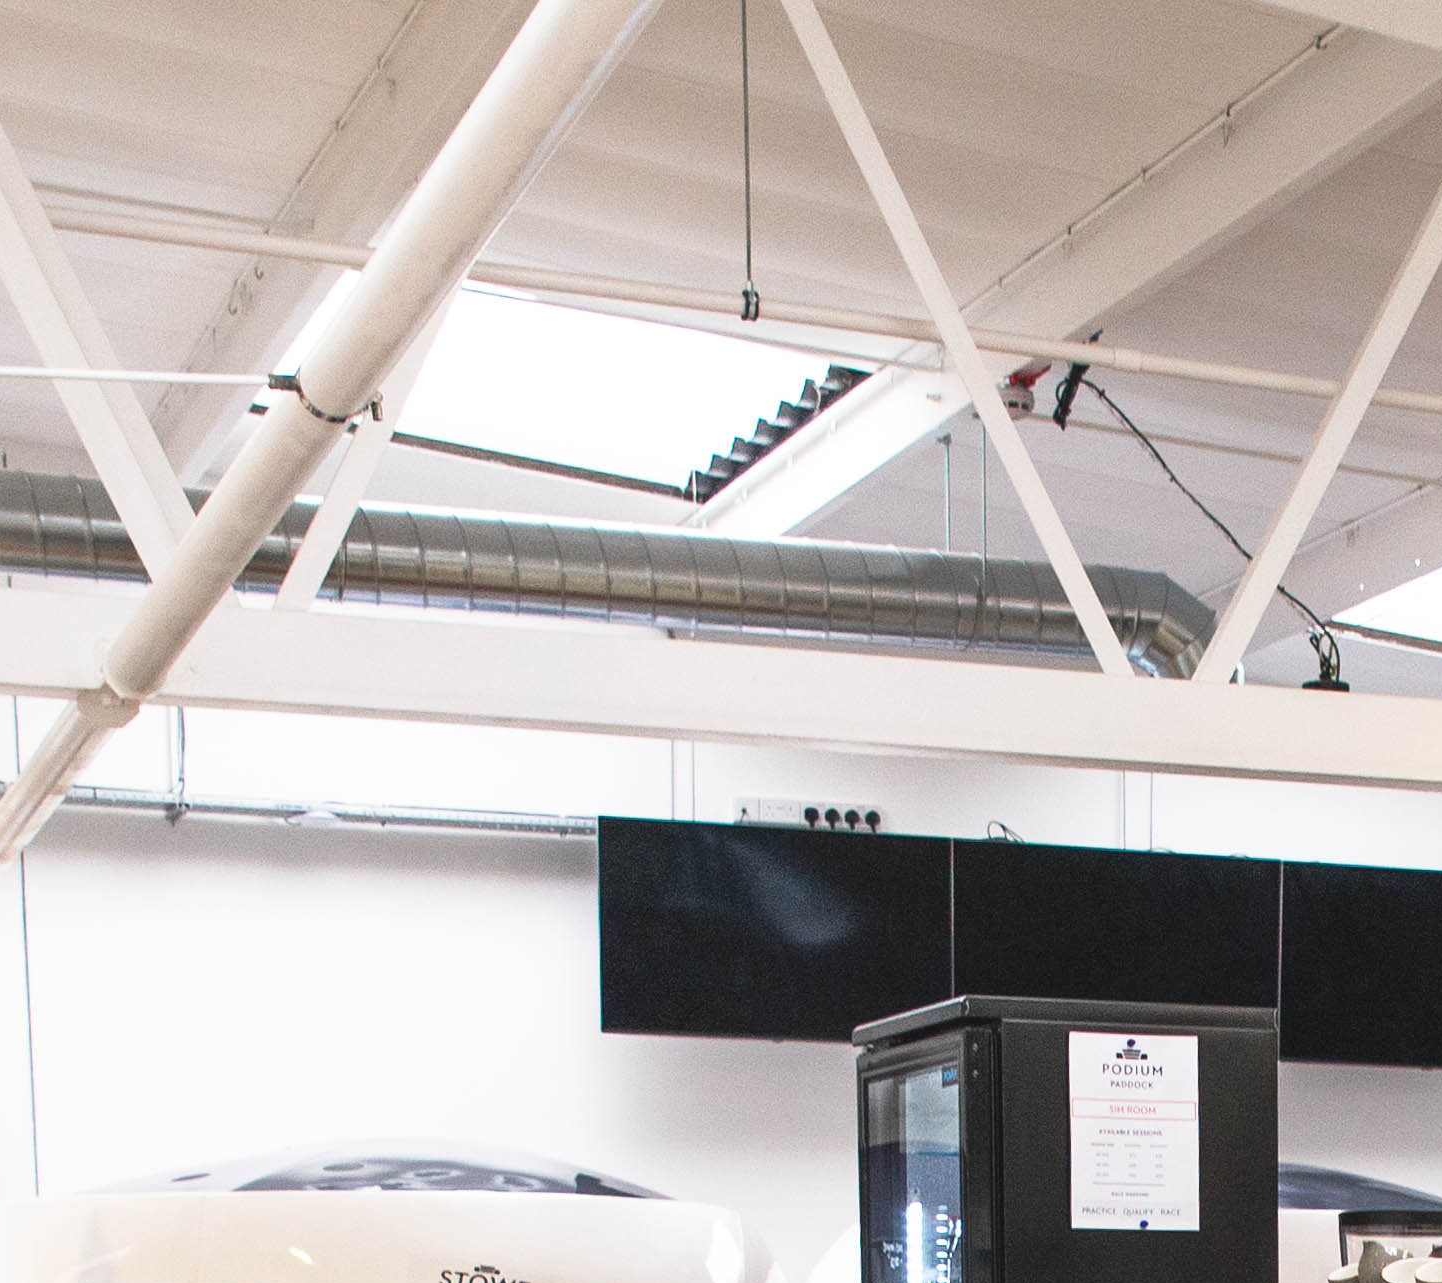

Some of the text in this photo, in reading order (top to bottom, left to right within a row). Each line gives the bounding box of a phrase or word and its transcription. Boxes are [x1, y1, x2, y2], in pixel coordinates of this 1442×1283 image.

[1102, 1064, 1163, 1076] PODIUM
[1110, 1080, 1154, 1089] PADDOCK
[1127, 1105, 1157, 1115] ROOM
[1082, 1207, 1182, 1217] PRACTICE QUALIFY RACE
